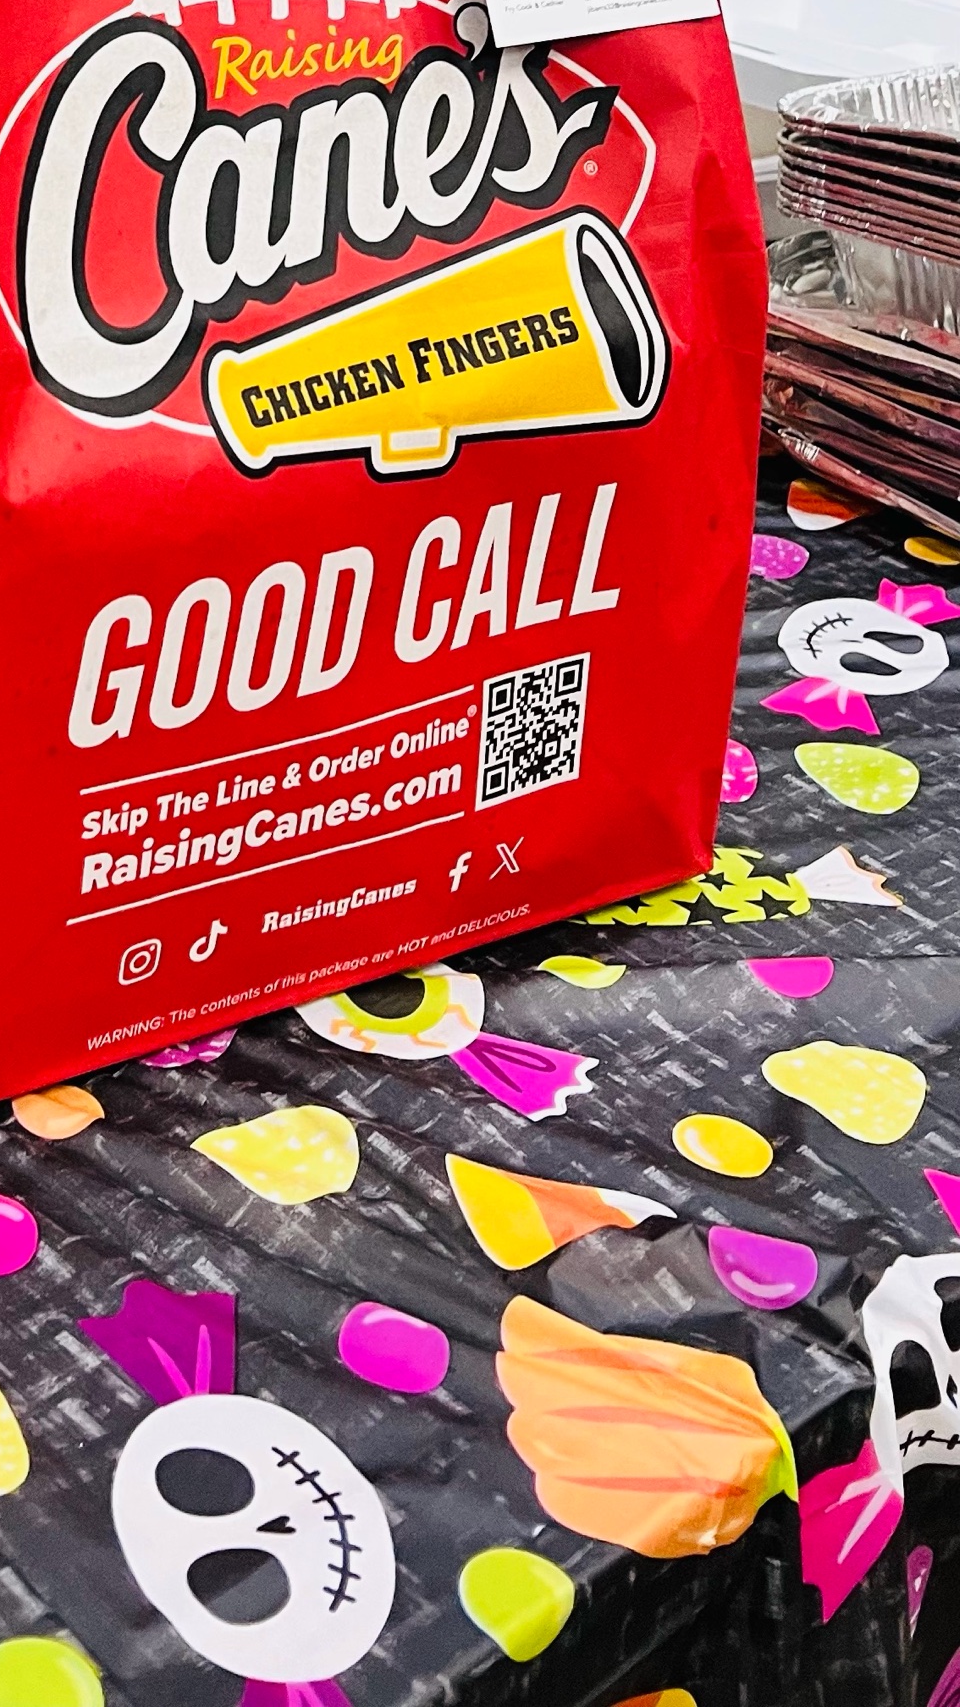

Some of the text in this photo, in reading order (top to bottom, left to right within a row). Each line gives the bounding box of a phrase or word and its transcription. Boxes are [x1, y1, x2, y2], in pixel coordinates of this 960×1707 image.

[212, 31, 404, 99] Raising
[18, 0, 618, 414] Cane's
[241, 305, 580, 429] CHICKEN FINGERS
[68, 482, 621, 749] GOOD CALL
[81, 802, 149, 839] Skip
[157, 791, 209, 822] The
[216, 775, 276, 807] Line
[282, 762, 302, 789] &
[308, 745, 385, 783] Order
[81, 763, 462, 895] RaisingCanes.com
[261, 879, 417, 934] RaisingCanes
[87, 903, 531, 1051] WARNING: The contents of this package are HOT and DELICIOUS.
